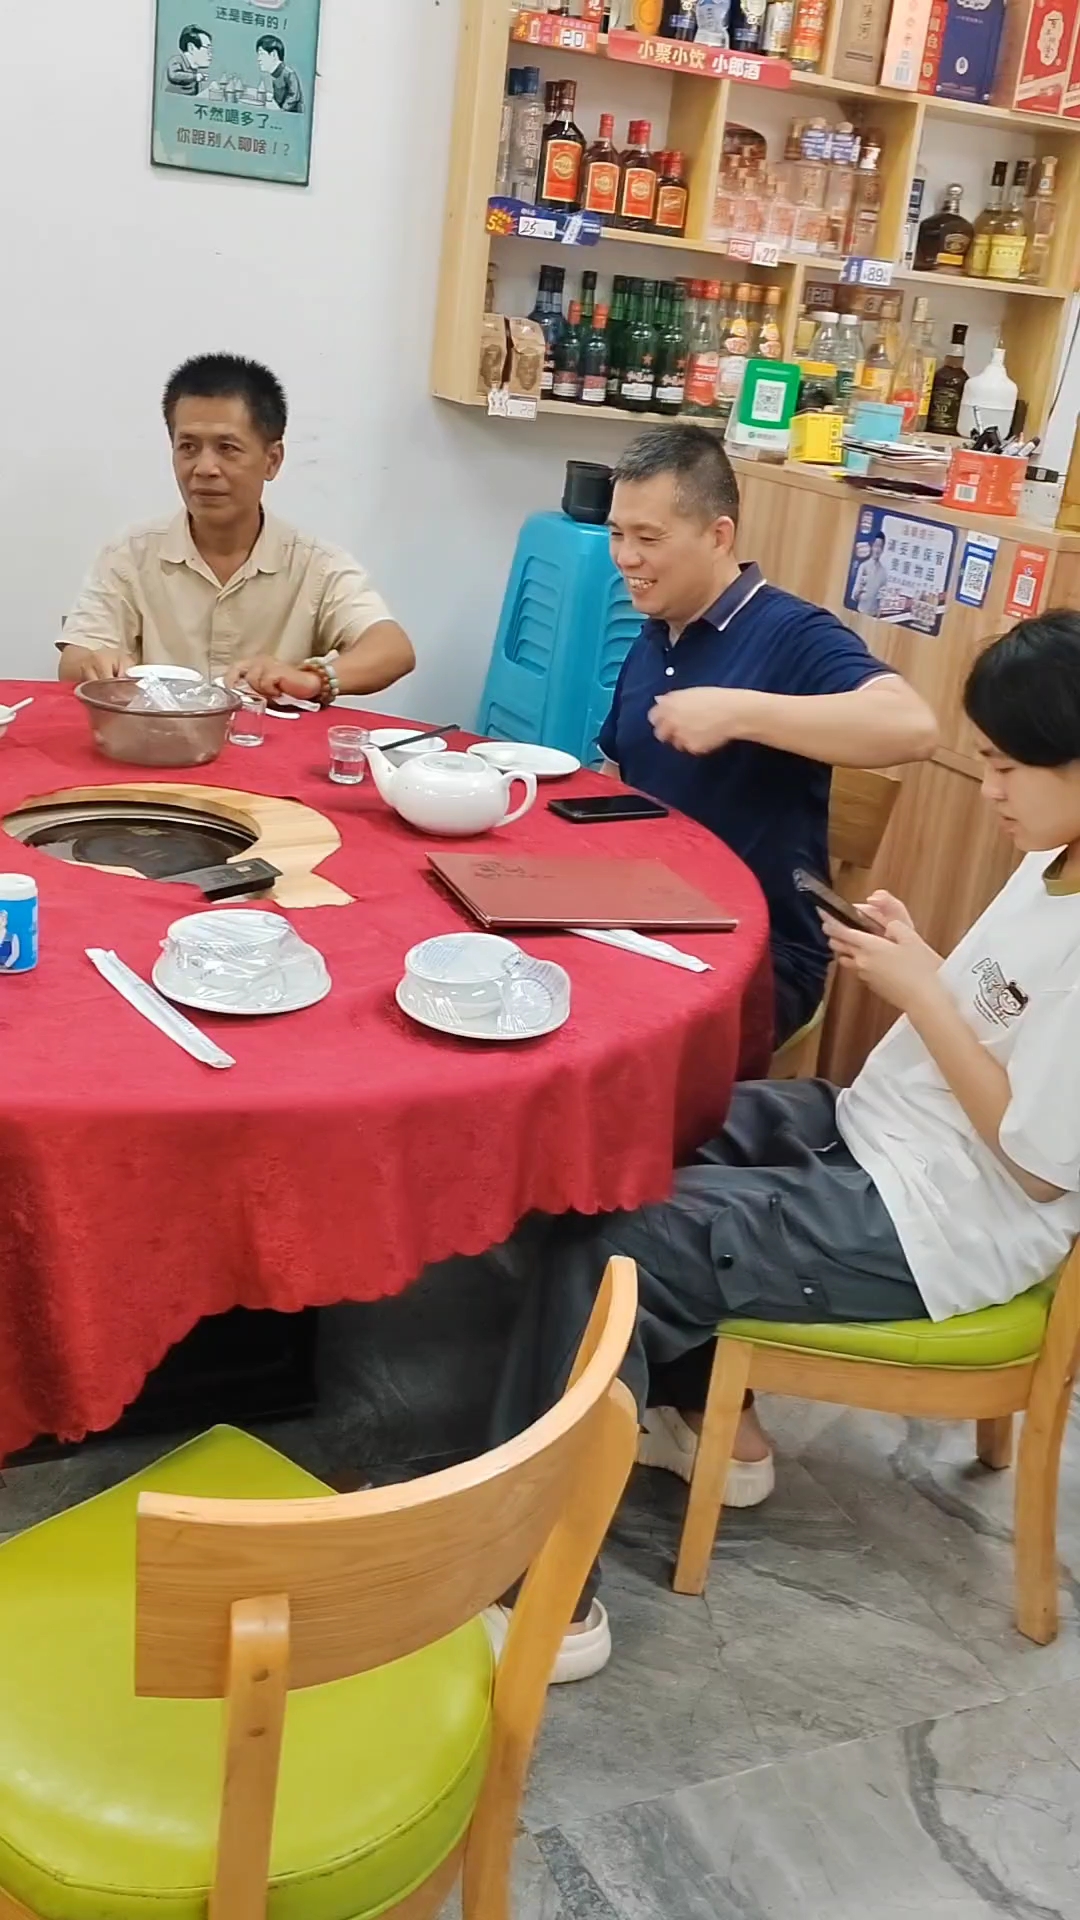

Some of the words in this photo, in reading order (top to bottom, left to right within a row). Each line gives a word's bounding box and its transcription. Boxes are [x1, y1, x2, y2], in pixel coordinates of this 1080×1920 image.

[638, 40, 705, 69] 小聚小饮
[712, 53, 764, 80] 小郎酒
